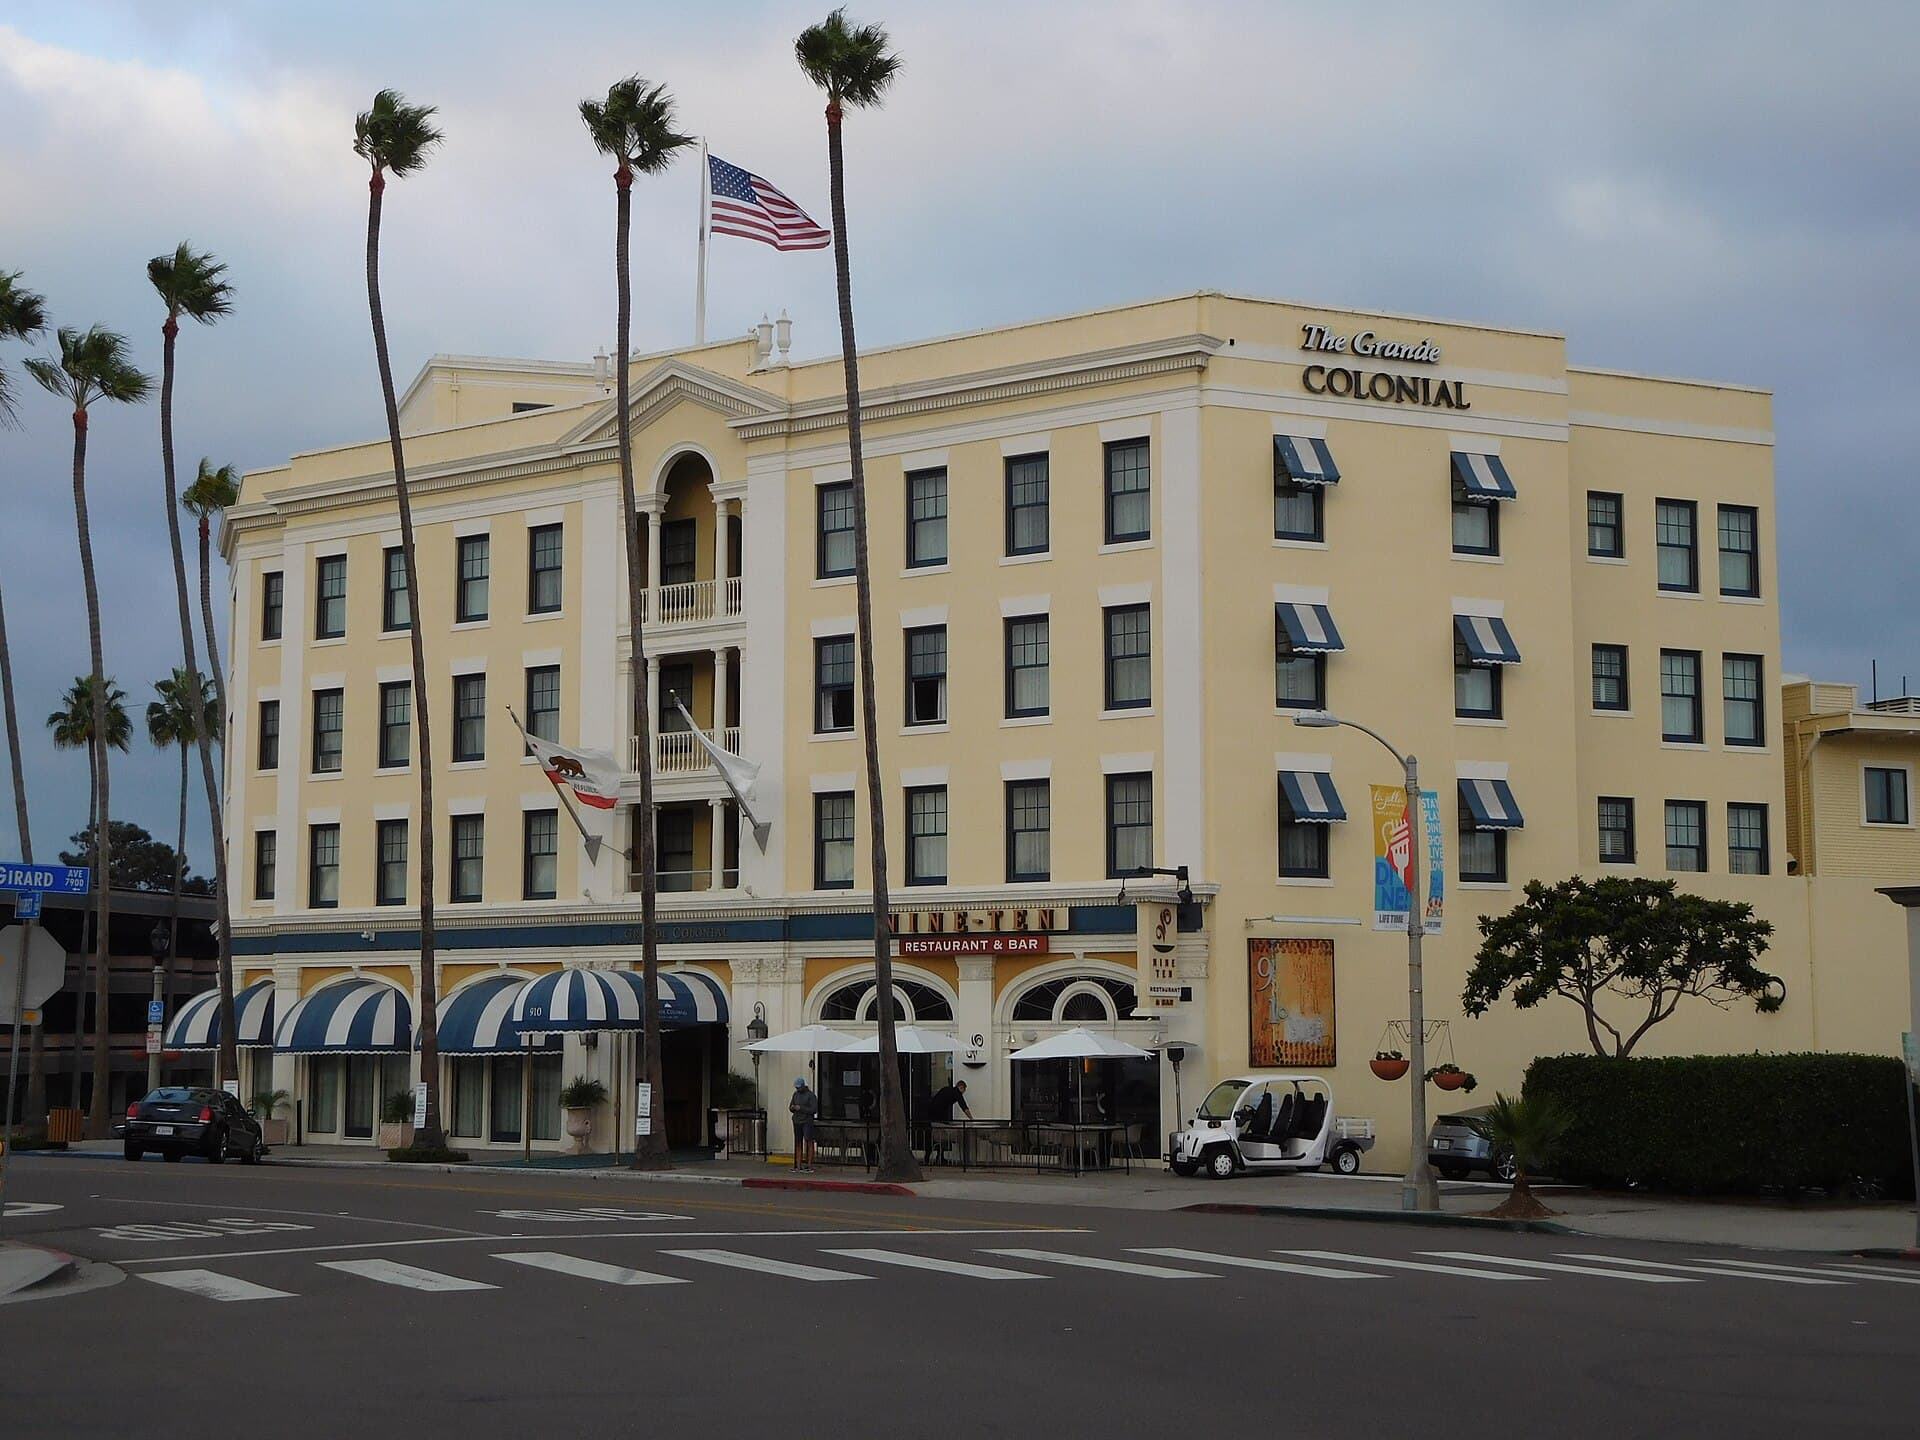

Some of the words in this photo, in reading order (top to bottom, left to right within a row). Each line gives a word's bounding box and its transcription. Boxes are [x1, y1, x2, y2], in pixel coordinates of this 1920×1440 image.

[1300, 324, 1347, 352] The
[1351, 330, 1441, 364] Grande
[1302, 365, 1471, 410] COLONIAL
[0, 866, 54, 887] GIRARD
[67, 869, 83, 878] AVE
[65, 878, 84, 887] 7900
[624, 927, 666, 939] GRDE
[905, 939, 989, 952] RESTAURANT
[993, 938, 1003, 950] &
[1008, 938, 1038, 951] BAR
[529, 1007, 542, 1017] 910
